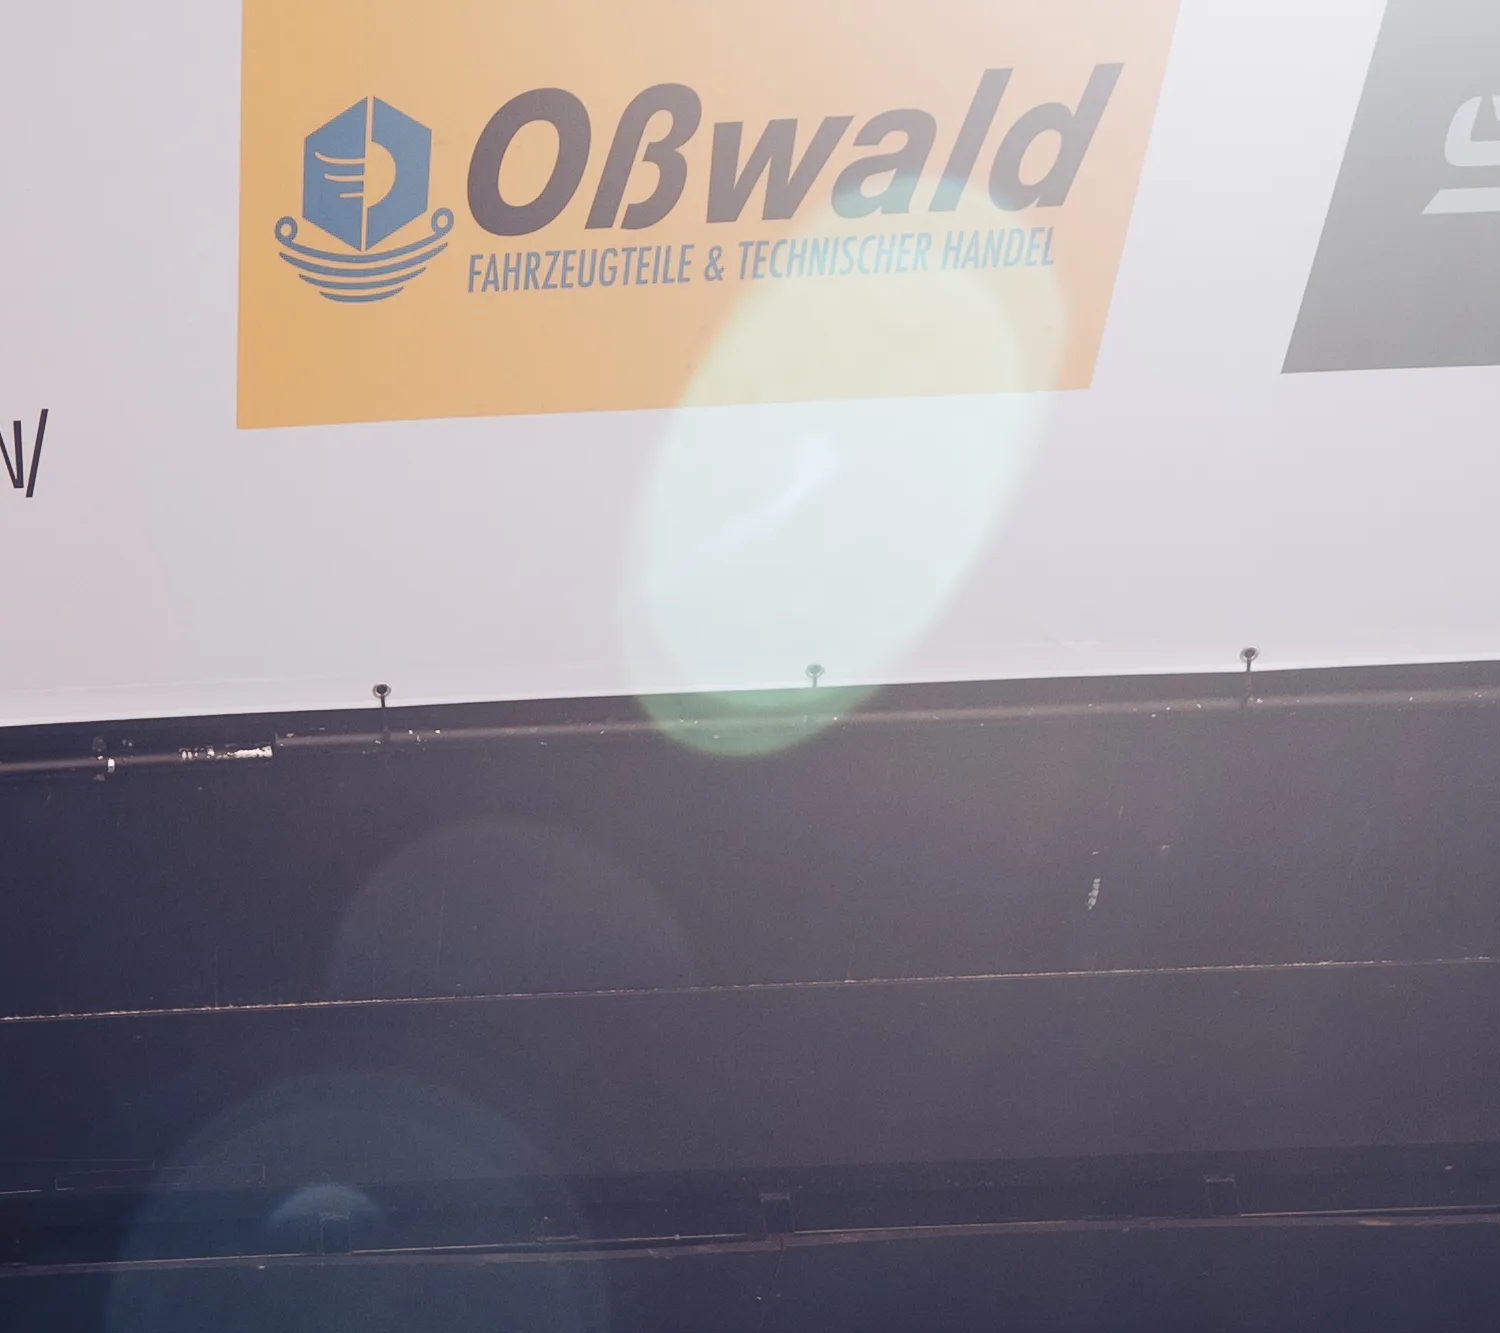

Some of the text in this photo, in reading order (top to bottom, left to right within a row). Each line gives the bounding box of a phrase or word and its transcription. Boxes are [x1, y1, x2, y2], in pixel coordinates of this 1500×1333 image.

[466, 62, 1124, 237] Oßwald
[466, 226, 1055, 294] FAHRZEUGTEILE & TECHNISCHER HANDEL
